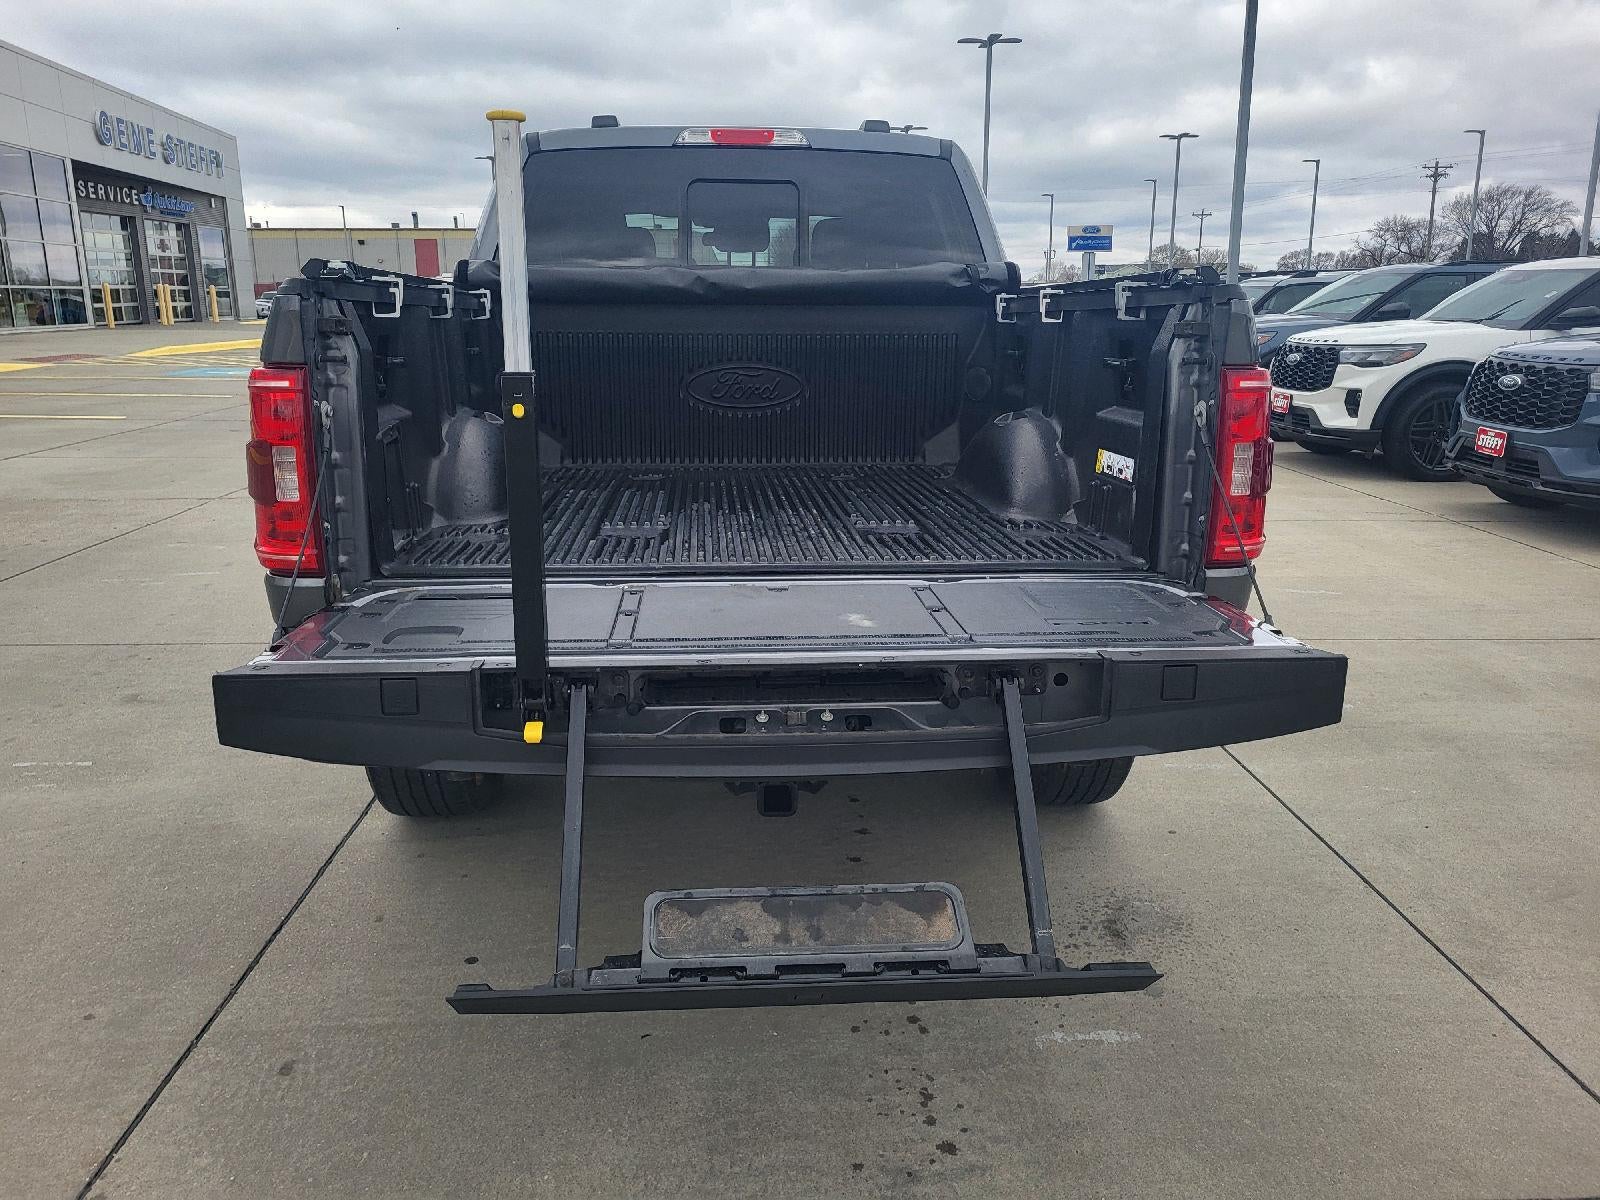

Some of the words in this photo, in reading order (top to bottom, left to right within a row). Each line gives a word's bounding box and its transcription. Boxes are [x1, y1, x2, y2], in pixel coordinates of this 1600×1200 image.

[95, 110, 157, 159] GENE
[163, 131, 224, 179] STEFFY
[78, 180, 140, 205] SERVICE
[711, 370, 781, 399] Ford
[1478, 434, 1504, 450] STEFFY
